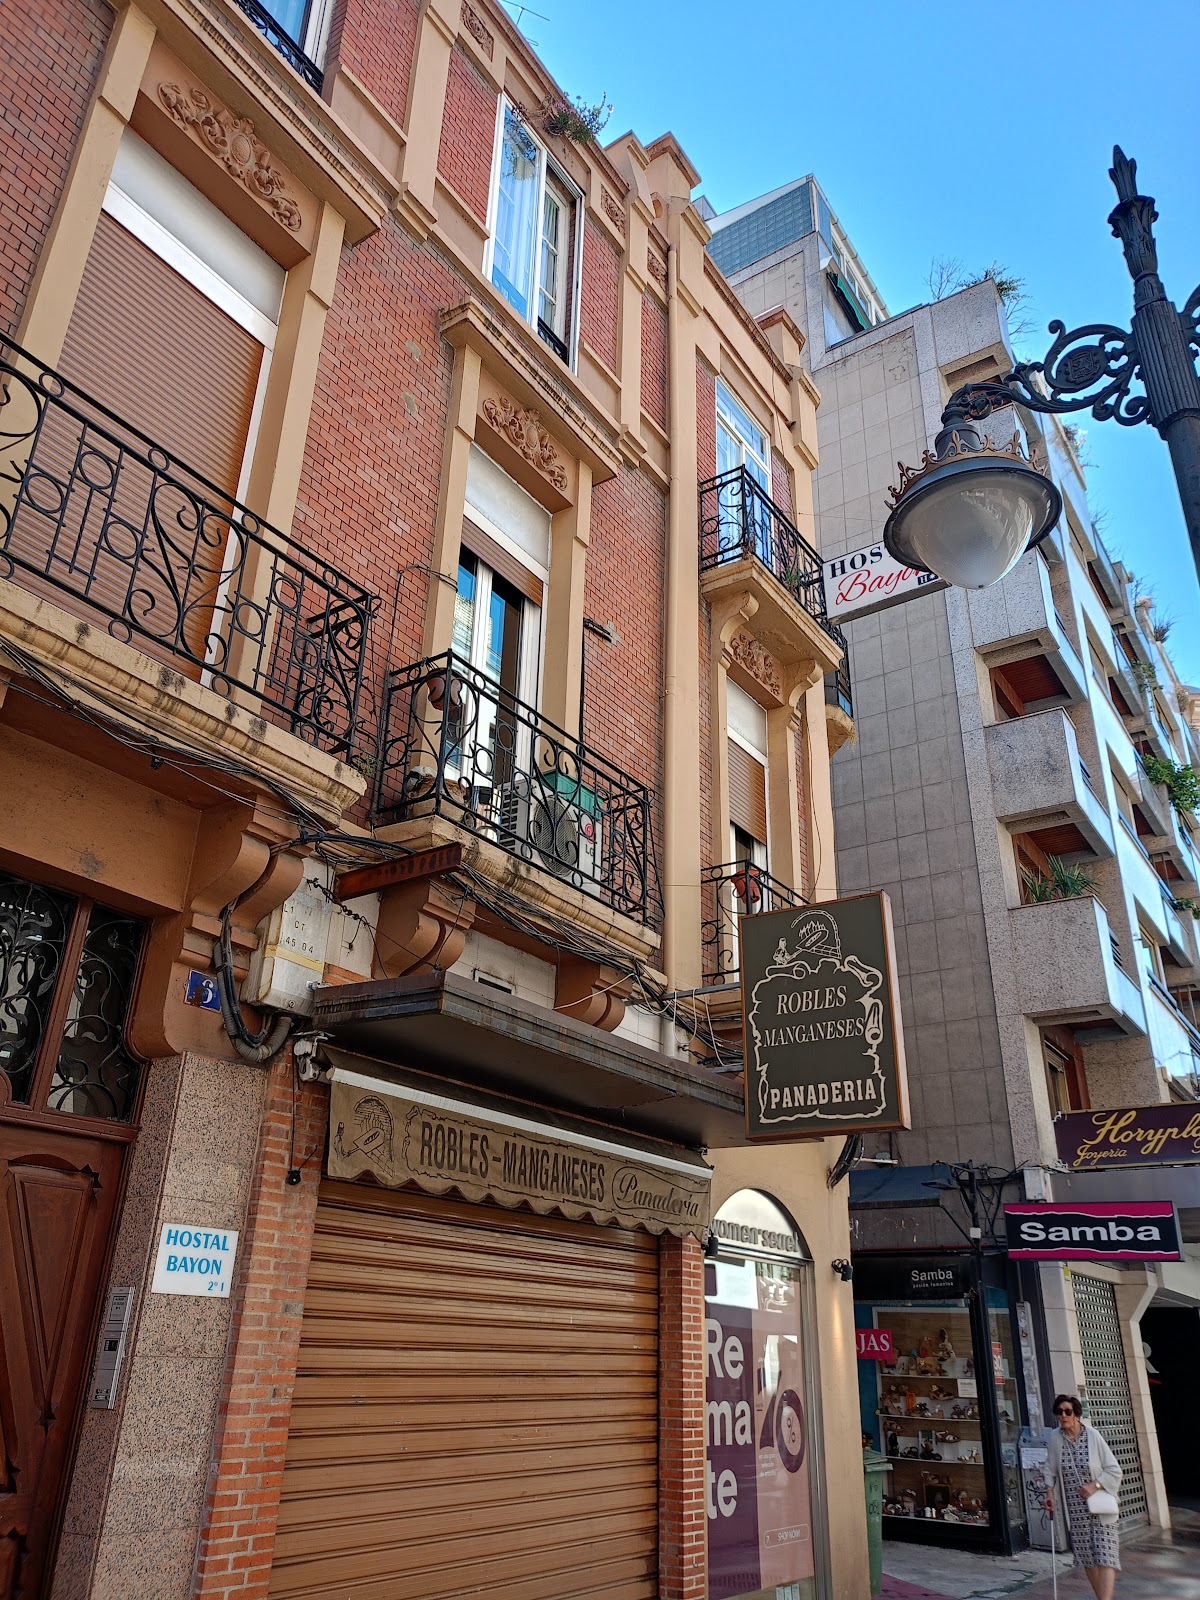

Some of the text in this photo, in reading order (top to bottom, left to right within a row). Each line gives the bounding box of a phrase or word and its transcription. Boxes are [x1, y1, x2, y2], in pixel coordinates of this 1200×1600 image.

[829, 545, 892, 579] HOS
[776, 985, 847, 1015] ROBLES
[763, 1017, 865, 1048] MANGANESES
[770, 1078, 877, 1109] PANADERIA
[166, 1229, 229, 1251] HOSTAL
[1020, 1221, 1161, 1242] Samba
[166, 1255, 222, 1276] BAYON
[911, 1269, 953, 1281] Samba
[856, 1333, 890, 1354] JAS
[706, 1400, 752, 1446] ma
[707, 1459, 738, 1520] te
